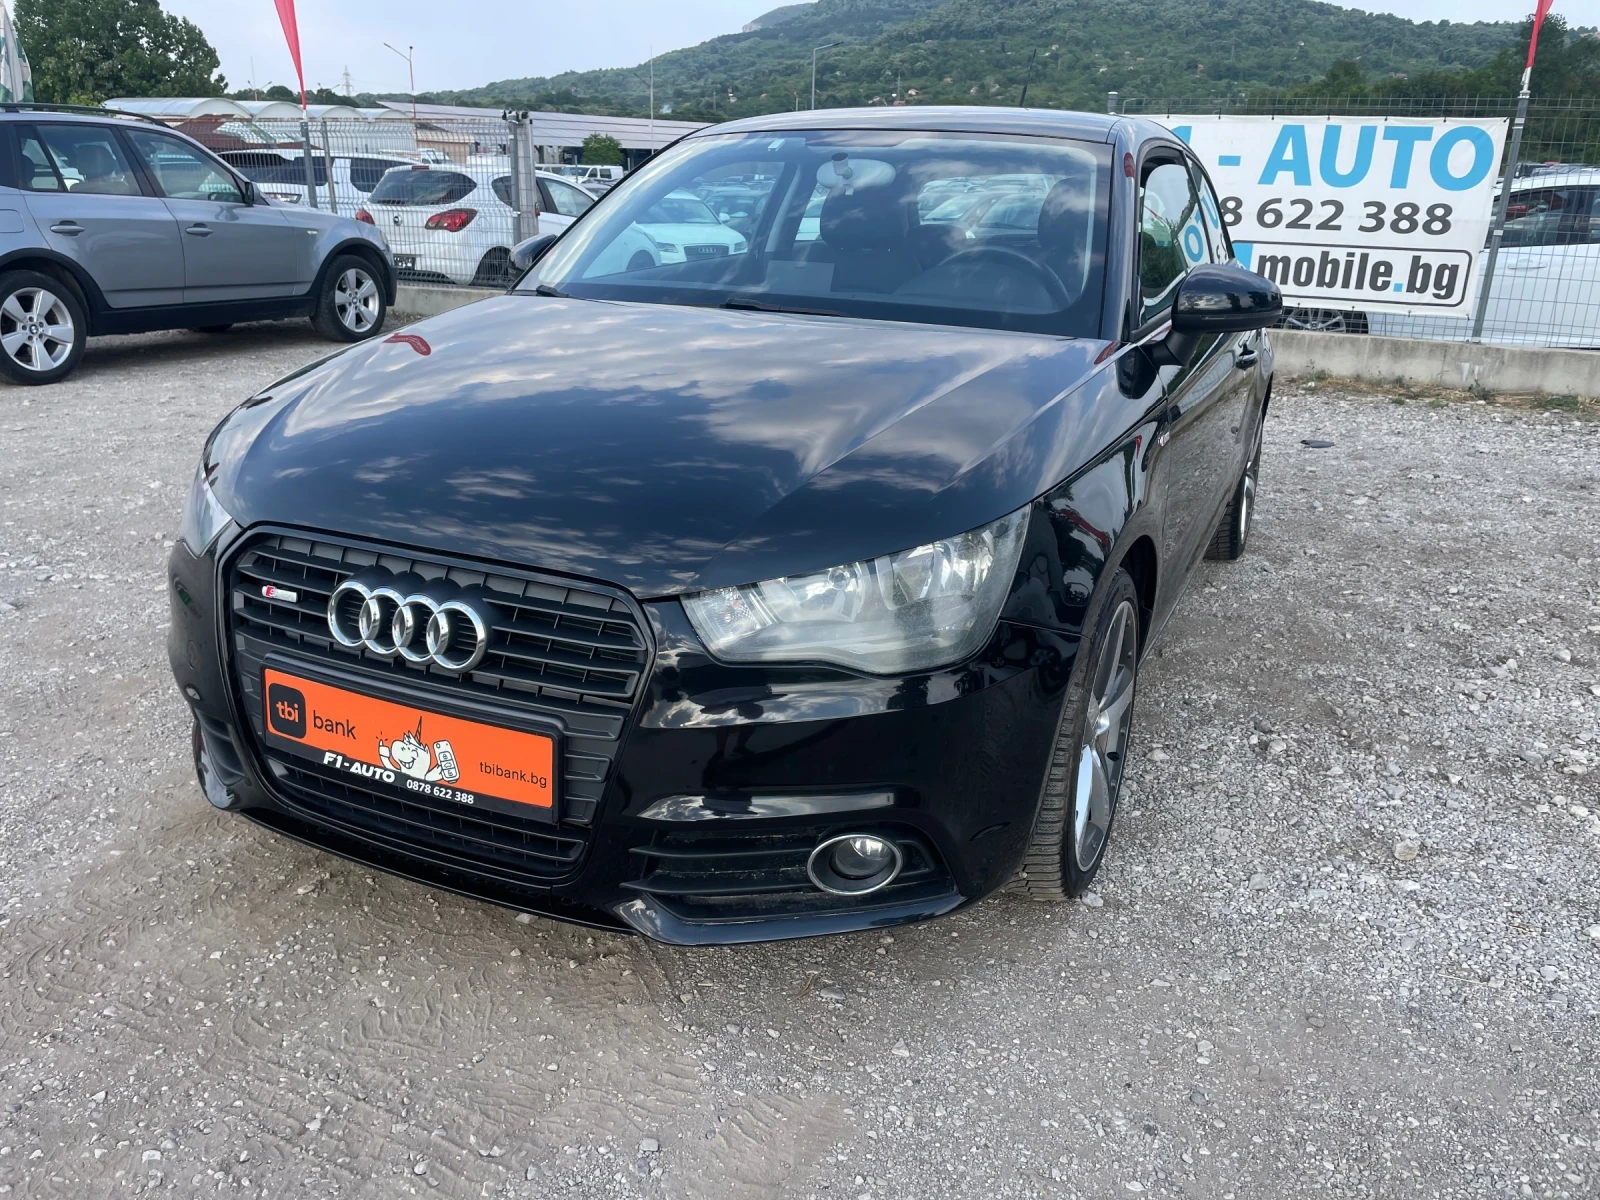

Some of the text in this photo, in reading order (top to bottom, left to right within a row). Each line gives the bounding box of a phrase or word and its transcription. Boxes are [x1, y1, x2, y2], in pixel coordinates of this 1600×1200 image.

[1258, 125, 1494, 191] AUTO
[1256, 198, 1344, 231] 622
[1358, 201, 1454, 235] 388
[1258, 250, 1460, 299] mobile.bg
[276, 700, 356, 740] tbi bank
[323, 752, 395, 783] F1-AUTO
[479, 761, 547, 788] tbibank.bg
[406, 779, 474, 805] 0878 622 388
